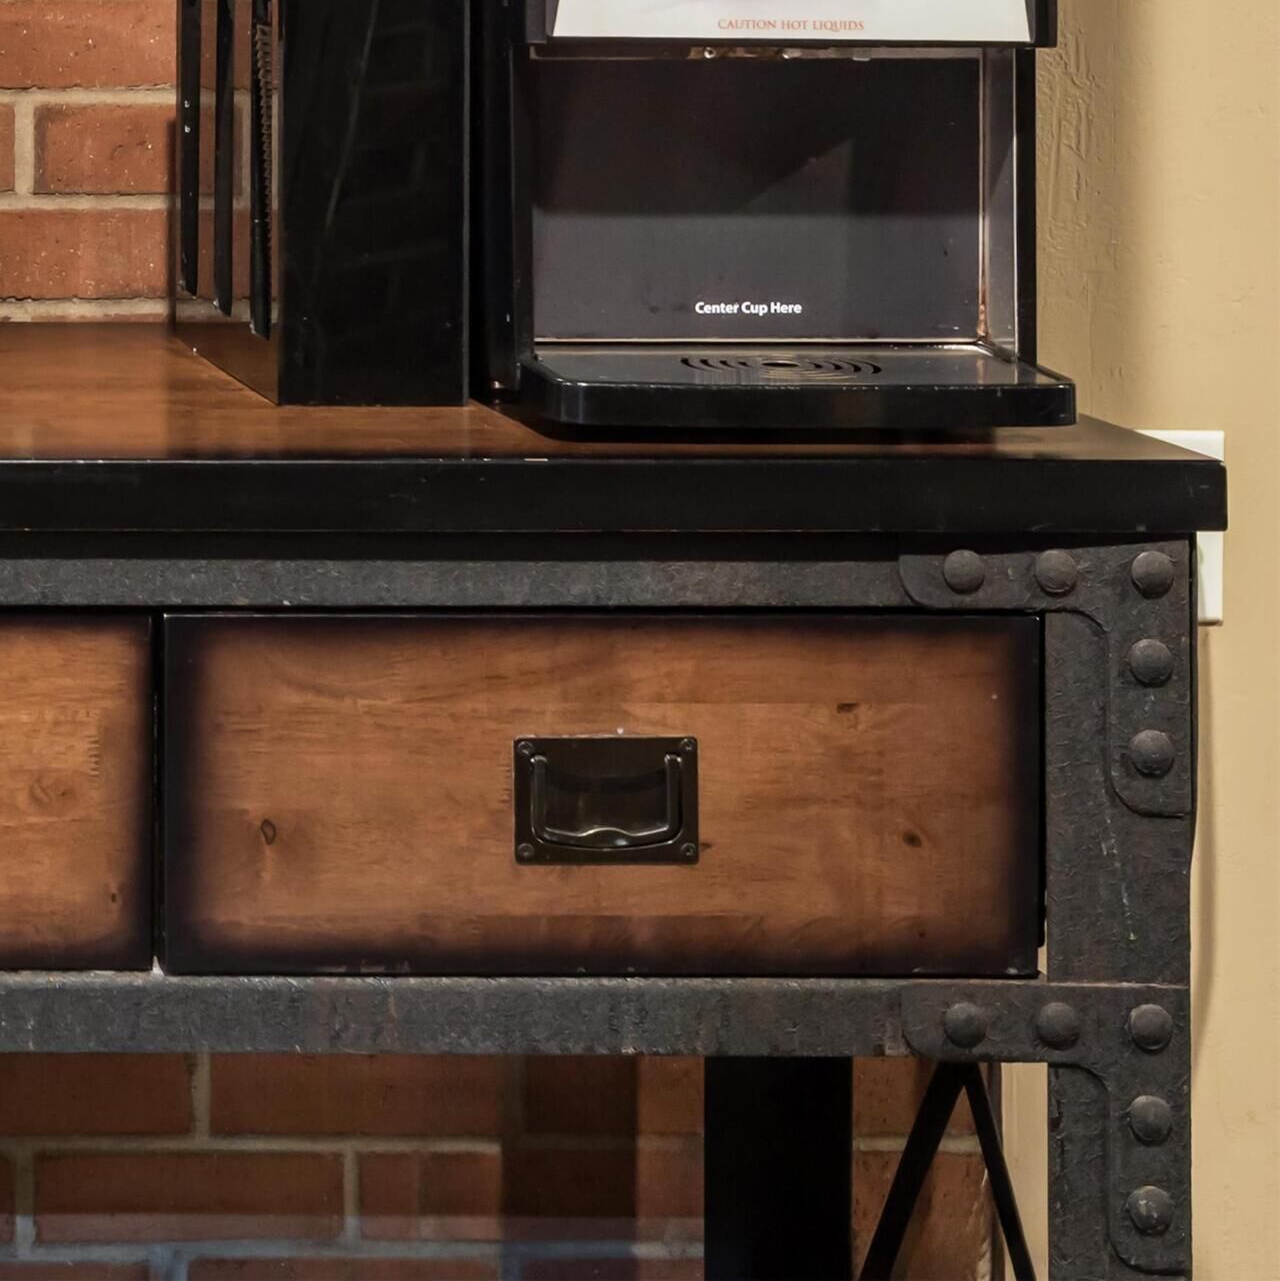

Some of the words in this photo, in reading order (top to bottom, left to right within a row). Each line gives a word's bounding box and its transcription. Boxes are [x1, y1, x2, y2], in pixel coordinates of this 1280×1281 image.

[717, 19, 777, 31] CAUTION
[781, 19, 809, 31] HOT
[812, 20, 865, 33] LIQUIDS
[694, 301, 740, 314] Center
[741, 301, 769, 317] Cup
[770, 301, 803, 314] Here
